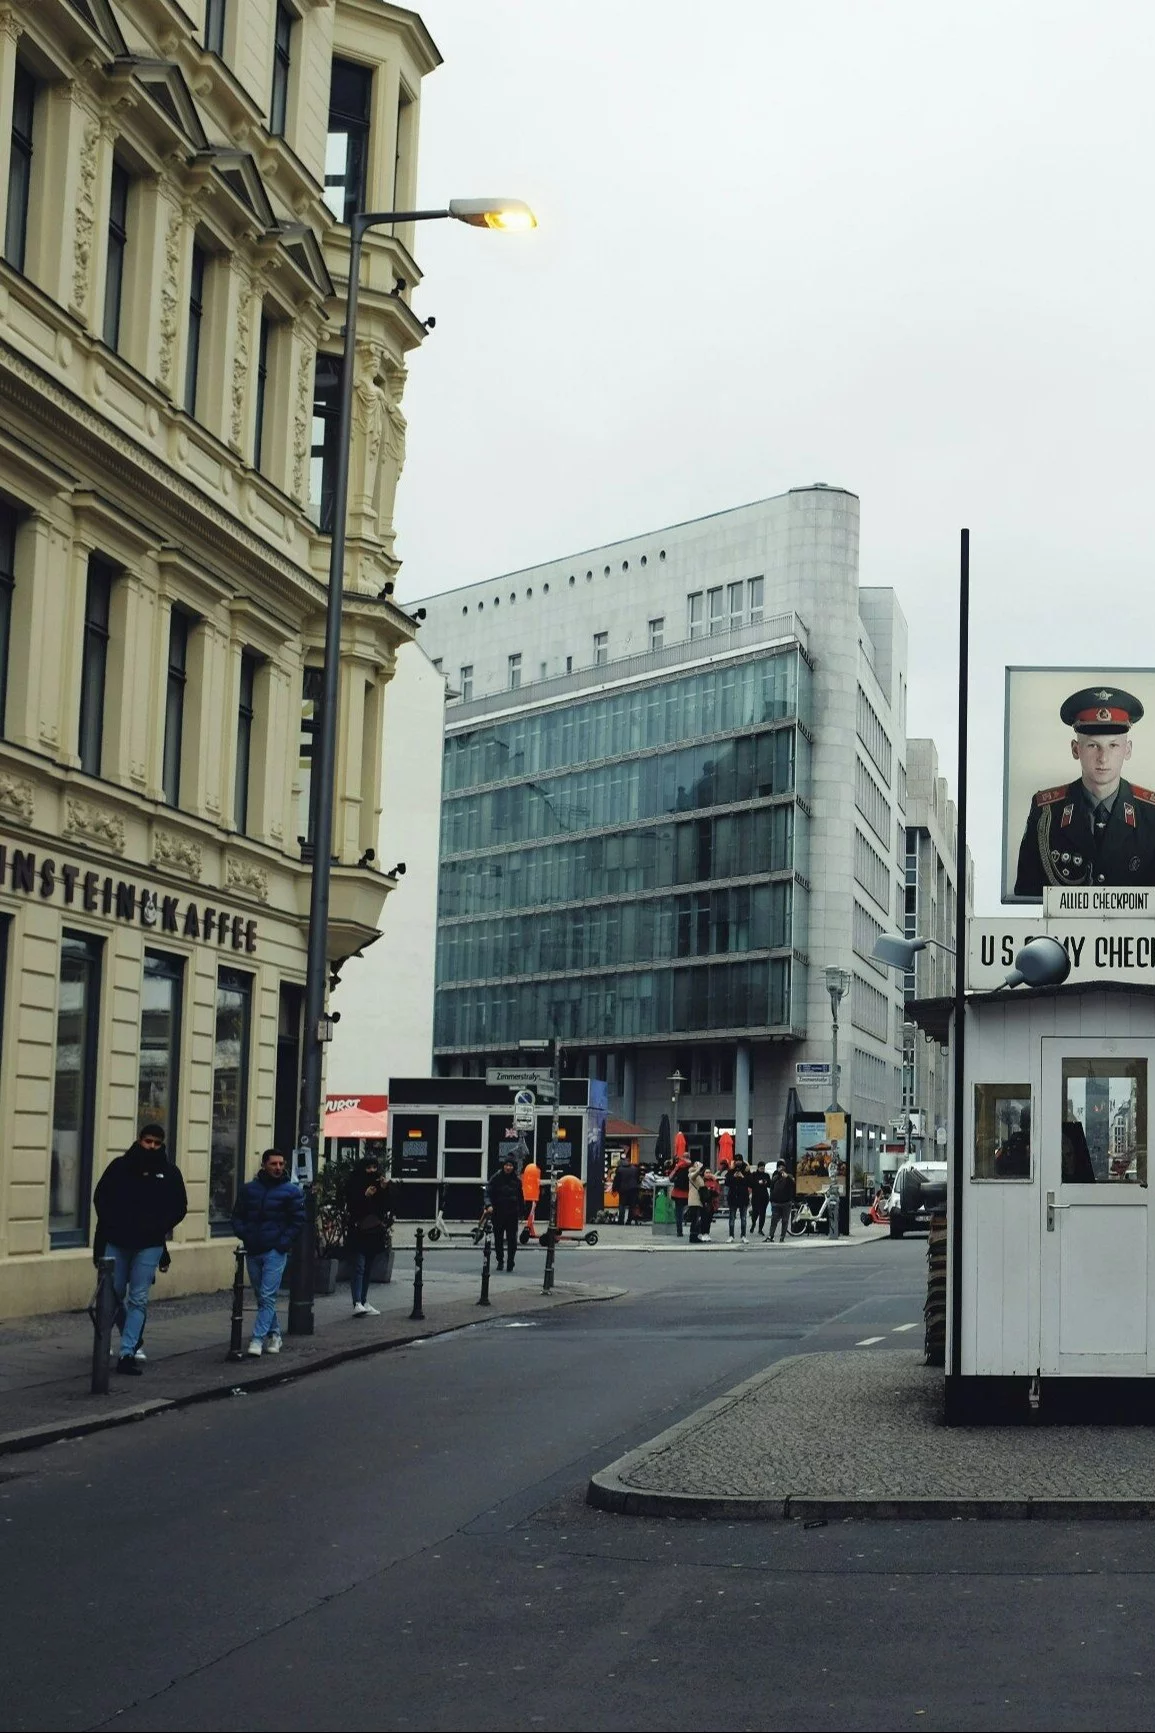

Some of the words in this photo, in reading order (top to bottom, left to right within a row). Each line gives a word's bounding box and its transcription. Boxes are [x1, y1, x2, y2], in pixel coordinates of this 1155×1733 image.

[1059, 893, 1089, 910] ALLIED
[1092, 892, 1150, 910] CHECKPOINT
[162, 895, 258, 953] KAFFEE
